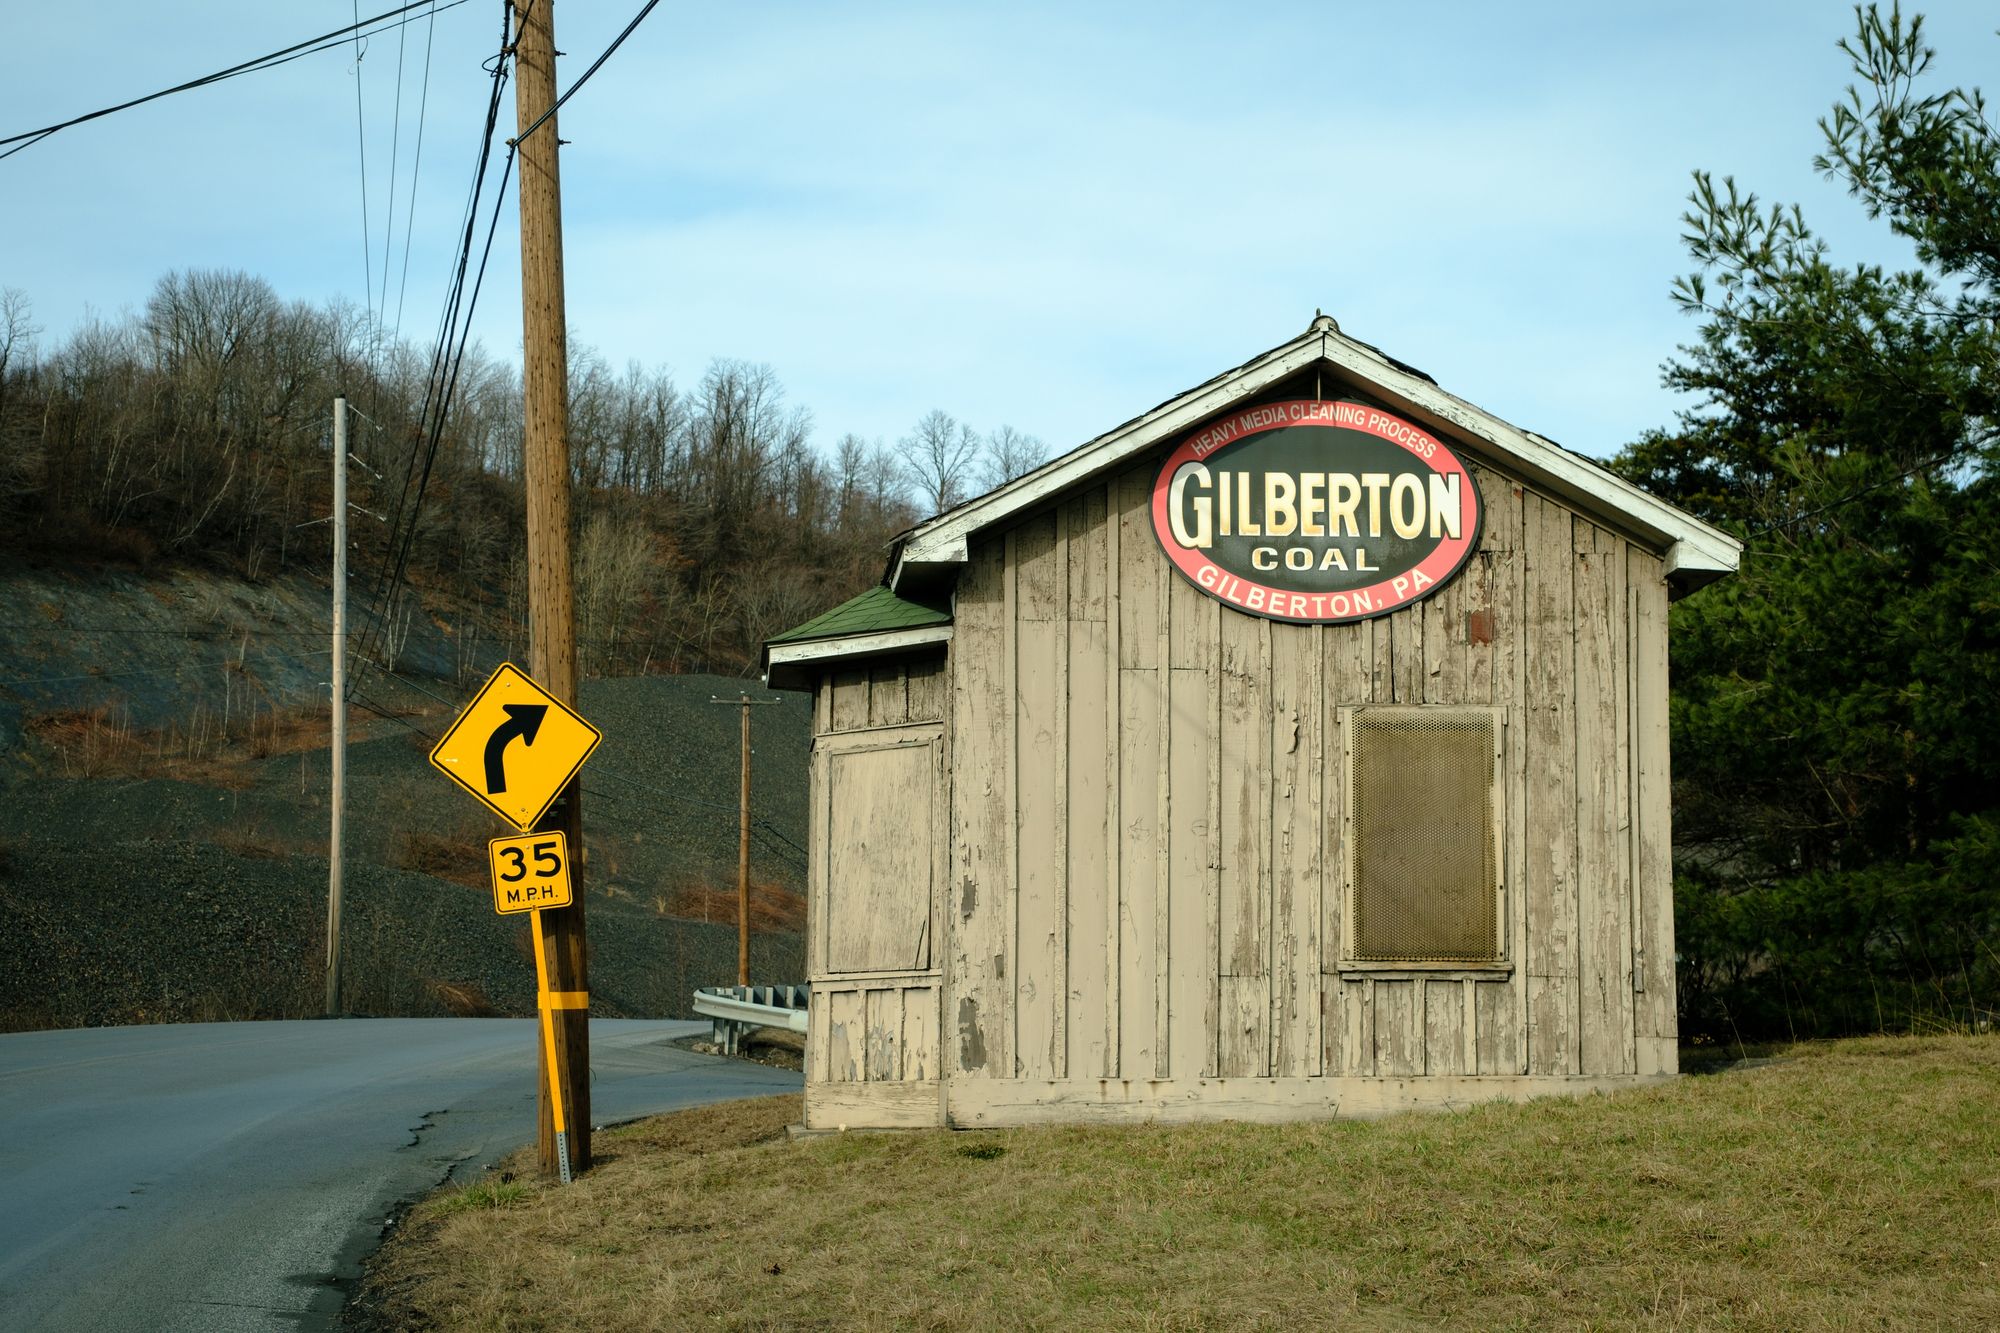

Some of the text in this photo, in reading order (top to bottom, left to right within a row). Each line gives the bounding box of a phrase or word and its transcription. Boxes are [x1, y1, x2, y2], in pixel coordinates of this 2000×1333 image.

[1191, 403, 1438, 459] HEAVY MEDIA CLEANING PROCESS
[1169, 461, 1461, 549] GILBERTON
[1251, 547, 1380, 572] COAL
[1196, 565, 1434, 617] GILBERTON, PA
[499, 841, 561, 882] 35
[507, 885, 559, 904] M.P.H.
